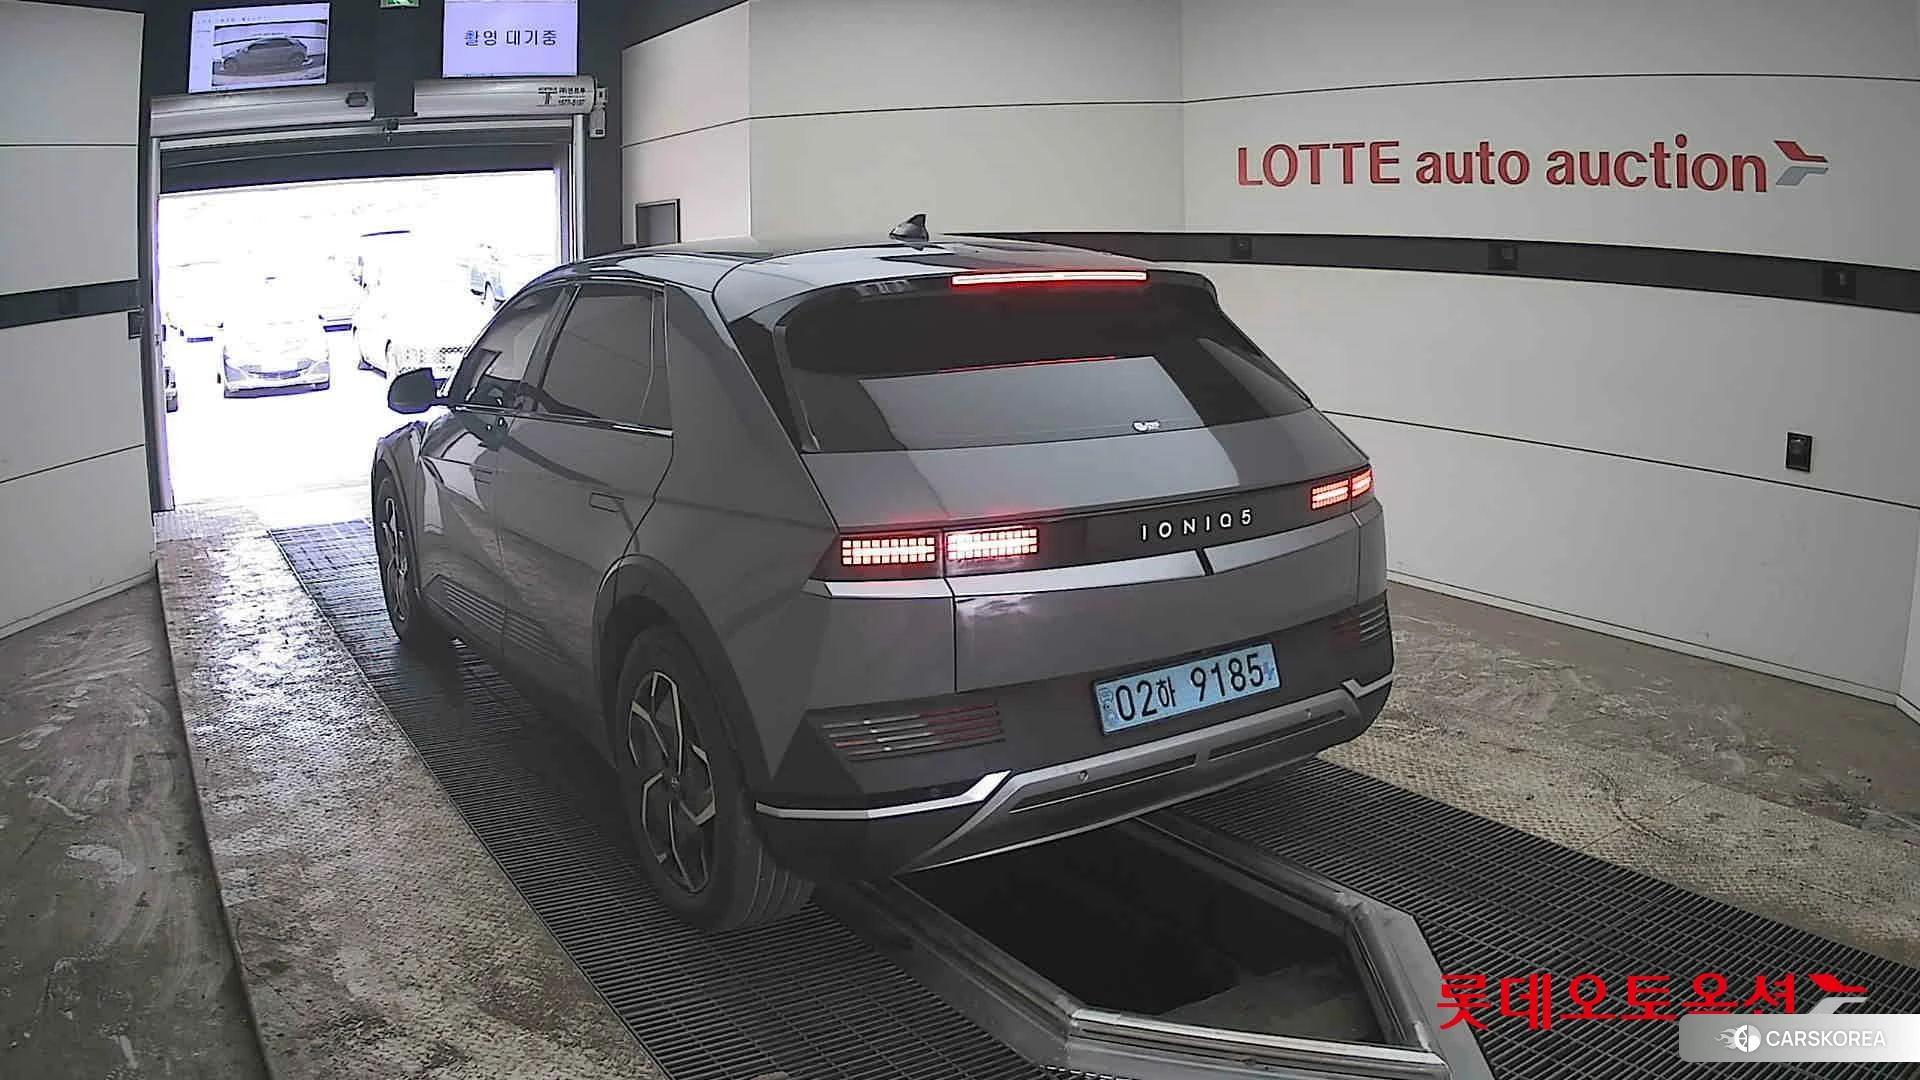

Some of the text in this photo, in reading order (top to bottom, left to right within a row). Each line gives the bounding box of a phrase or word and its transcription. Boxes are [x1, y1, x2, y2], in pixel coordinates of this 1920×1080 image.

[463, 29, 557, 47] 촬영 대기중
[1236, 134, 1768, 193] LOTTE auto auction
[1115, 652, 1265, 722] 02하 9185
